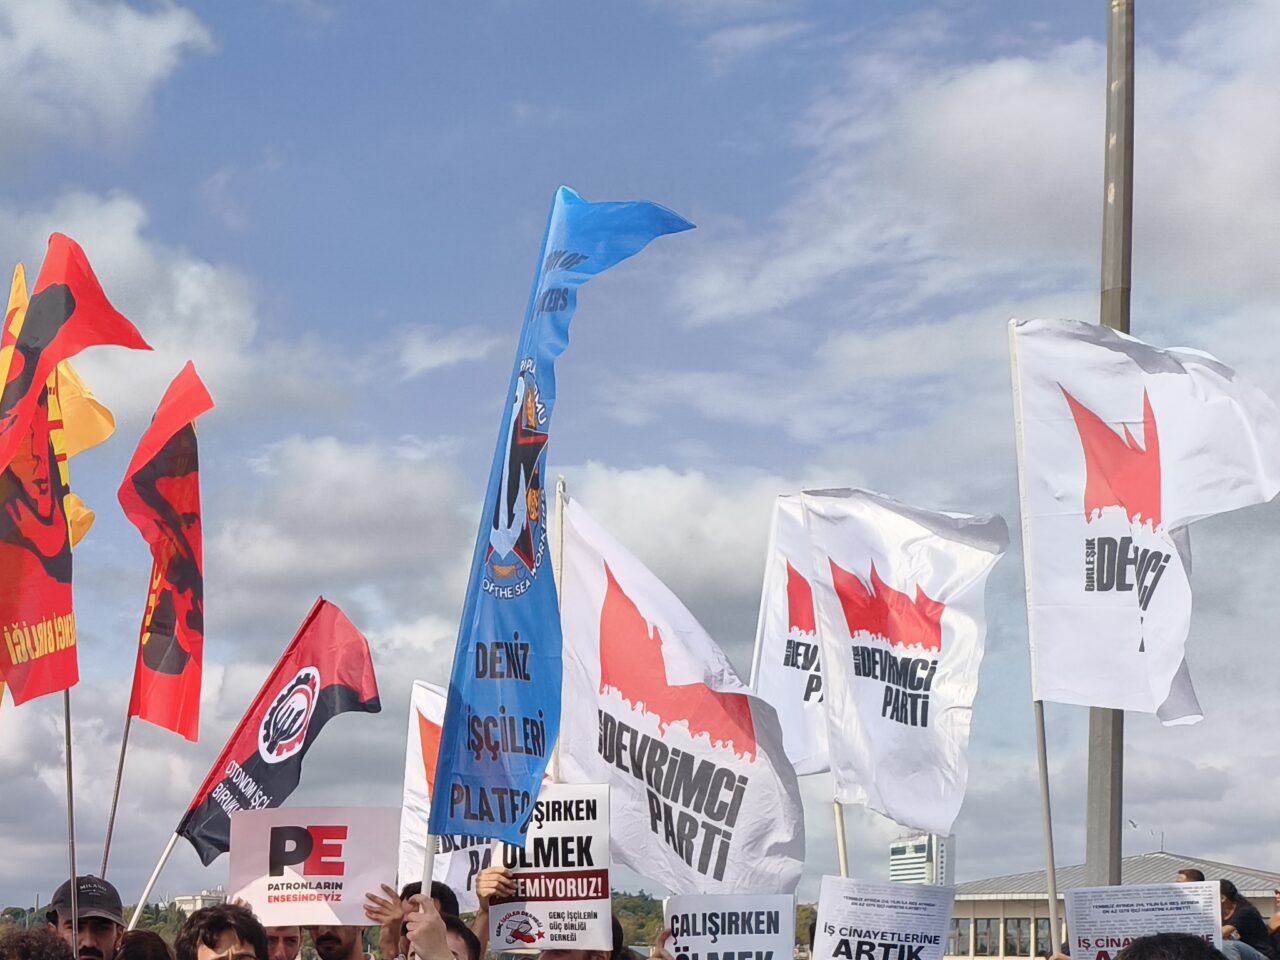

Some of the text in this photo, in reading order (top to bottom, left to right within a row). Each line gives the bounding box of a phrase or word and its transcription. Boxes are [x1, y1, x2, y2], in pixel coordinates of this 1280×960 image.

[495, 584, 514, 599] THE
[514, 579, 532, 598] SEA
[475, 631, 531, 681] DENİZ
[882, 685, 930, 727] PARTİ
[467, 706, 546, 763] İŞÇİLERİ
[225, 760, 257, 799] OTONOM
[602, 711, 749, 828] DEVRİMCİ
[450, 782, 531, 833] PLATFO
[647, 787, 733, 882] PARTİ
[269, 826, 348, 877] PE
[267, 881, 343, 891] PATRONLARIN
[267, 892, 342, 903] ENSESİNDEYİZ
[517, 875, 602, 897] EMİYORUZ!
[548, 910, 598, 921] GENÇ İŞÇİLERİN
[549, 922, 587, 932] GÜÇ BİRLİĞİ
[671, 911, 780, 945] ÇALIŞIRKEN
[550, 933, 576, 942] DERNEĞİ
[824, 922, 941, 945] İŞ CİNAYETLERİNE
[1078, 936, 1091, 950] İŞ
